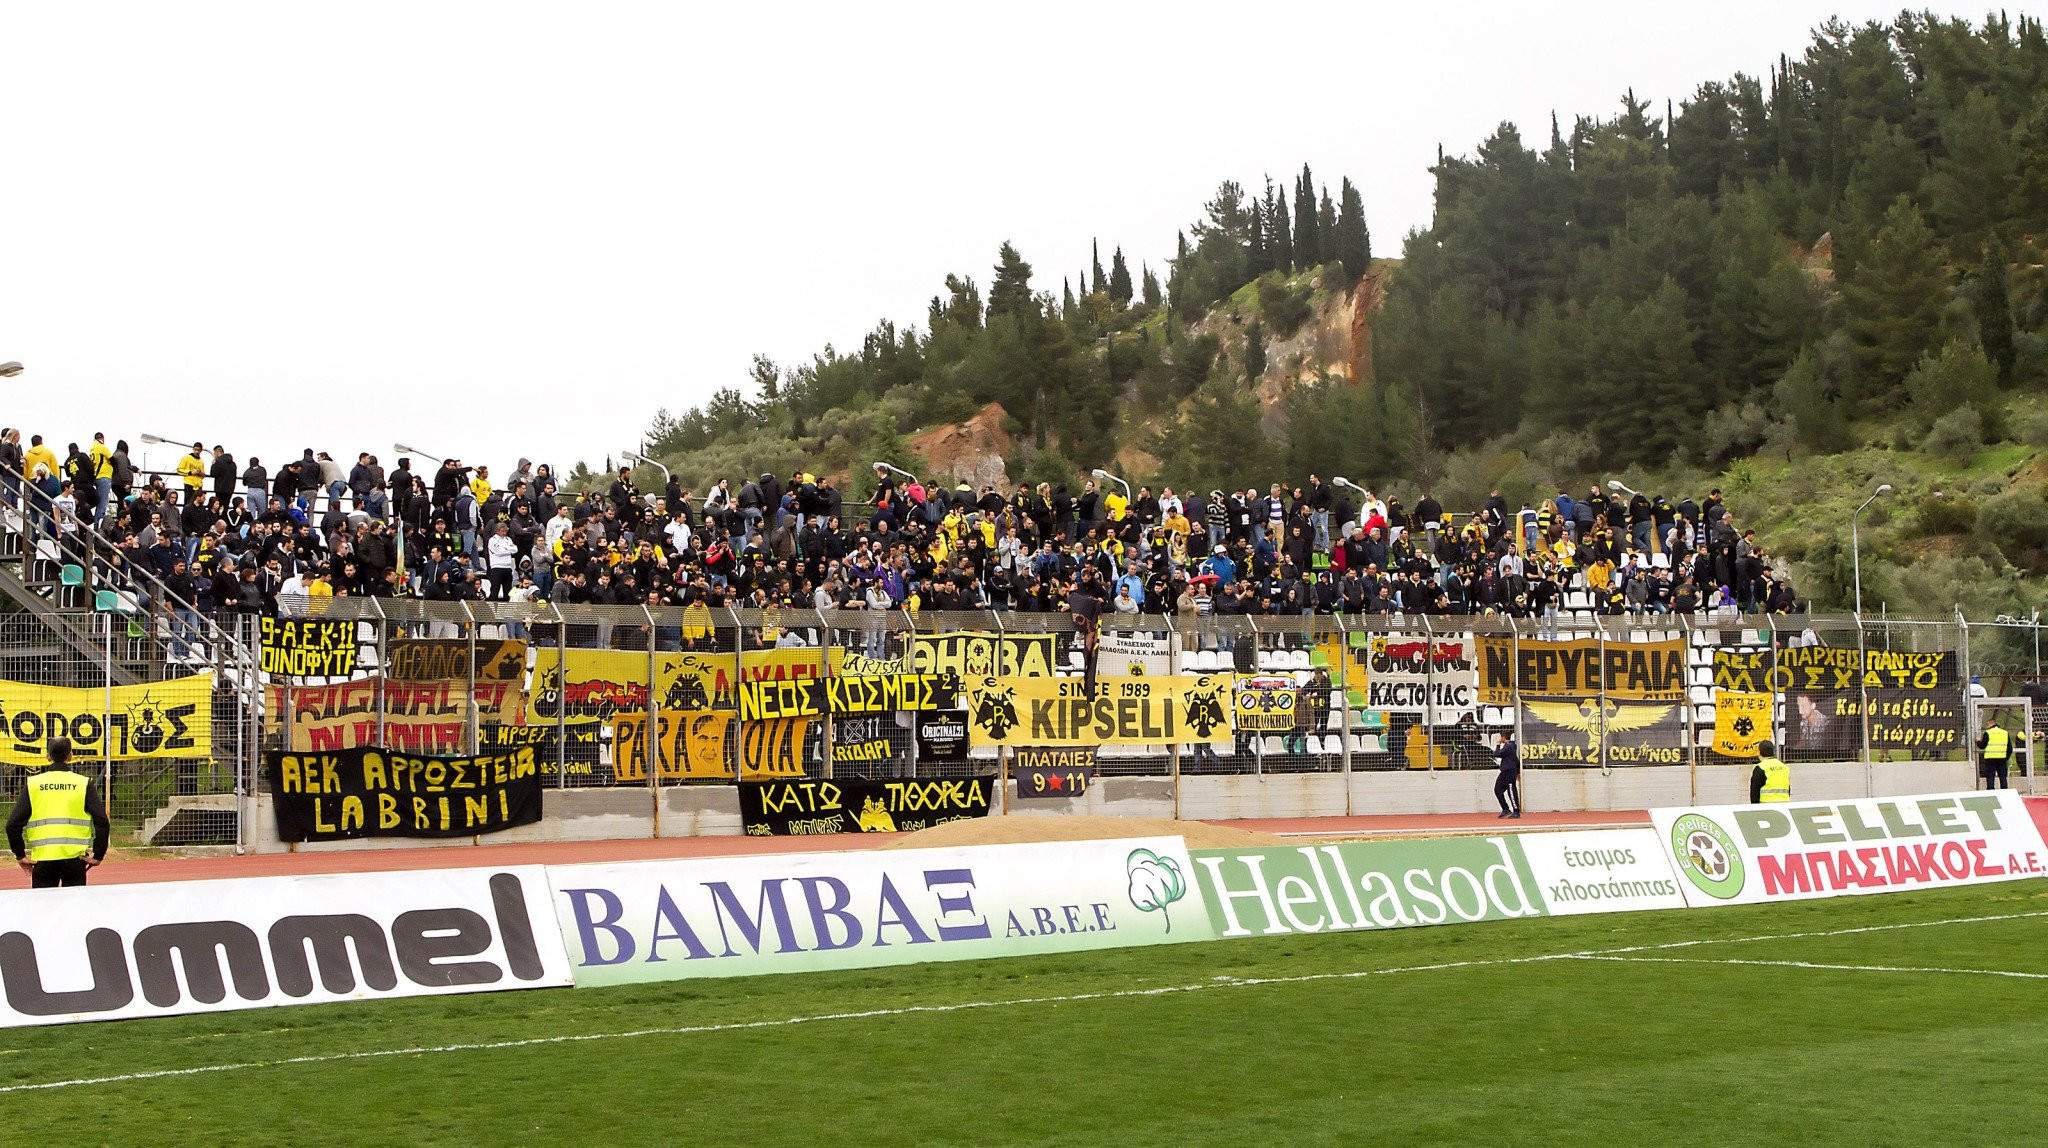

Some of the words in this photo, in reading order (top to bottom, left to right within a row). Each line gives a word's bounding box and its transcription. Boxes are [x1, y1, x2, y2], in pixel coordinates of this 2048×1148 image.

[1117, 640, 1155, 648] ΣΥΝΔΕΣΜΟΣ
[1867, 649, 1945, 671] ΠΑΝΤΟΥ
[1120, 682, 1151, 698] 1989
[1714, 665, 1938, 693] ΜΟΣΧΑΤΟ
[739, 679, 819, 721] ΝΕΟΣ
[826, 674, 938, 712] ΚΟΣΜΟΣ
[1031, 698, 1175, 740] KIPSELI
[1871, 724, 1955, 746] Γιώργαρε
[281, 755, 342, 793] ΑΕΚ
[363, 746, 536, 792] ΑΡΡΩΣΤΕΙΑ
[1017, 750, 1095, 768] ΠΛΑΤΑΙΕΣ
[39, 783, 77, 792] SECURITY
[1034, 772, 1046, 792] 9
[1066, 772, 1087, 792] 11
[315, 789, 508, 833] LABRINI
[760, 783, 842, 815] ΚΑΤΩ
[1732, 796, 2002, 847] PELLET
[1563, 846, 1637, 871] έτοιμος
[1757, 839, 2006, 896] ΜΠΑΣΙΑΚΟΣ
[2009, 851, 2047, 875] Α.Ε.
[1196, 837, 1542, 937] Hellasod
[1548, 876, 1677, 902] χλοοτάπητας
[560, 868, 992, 967] ΒΑΜΒΑΞ
